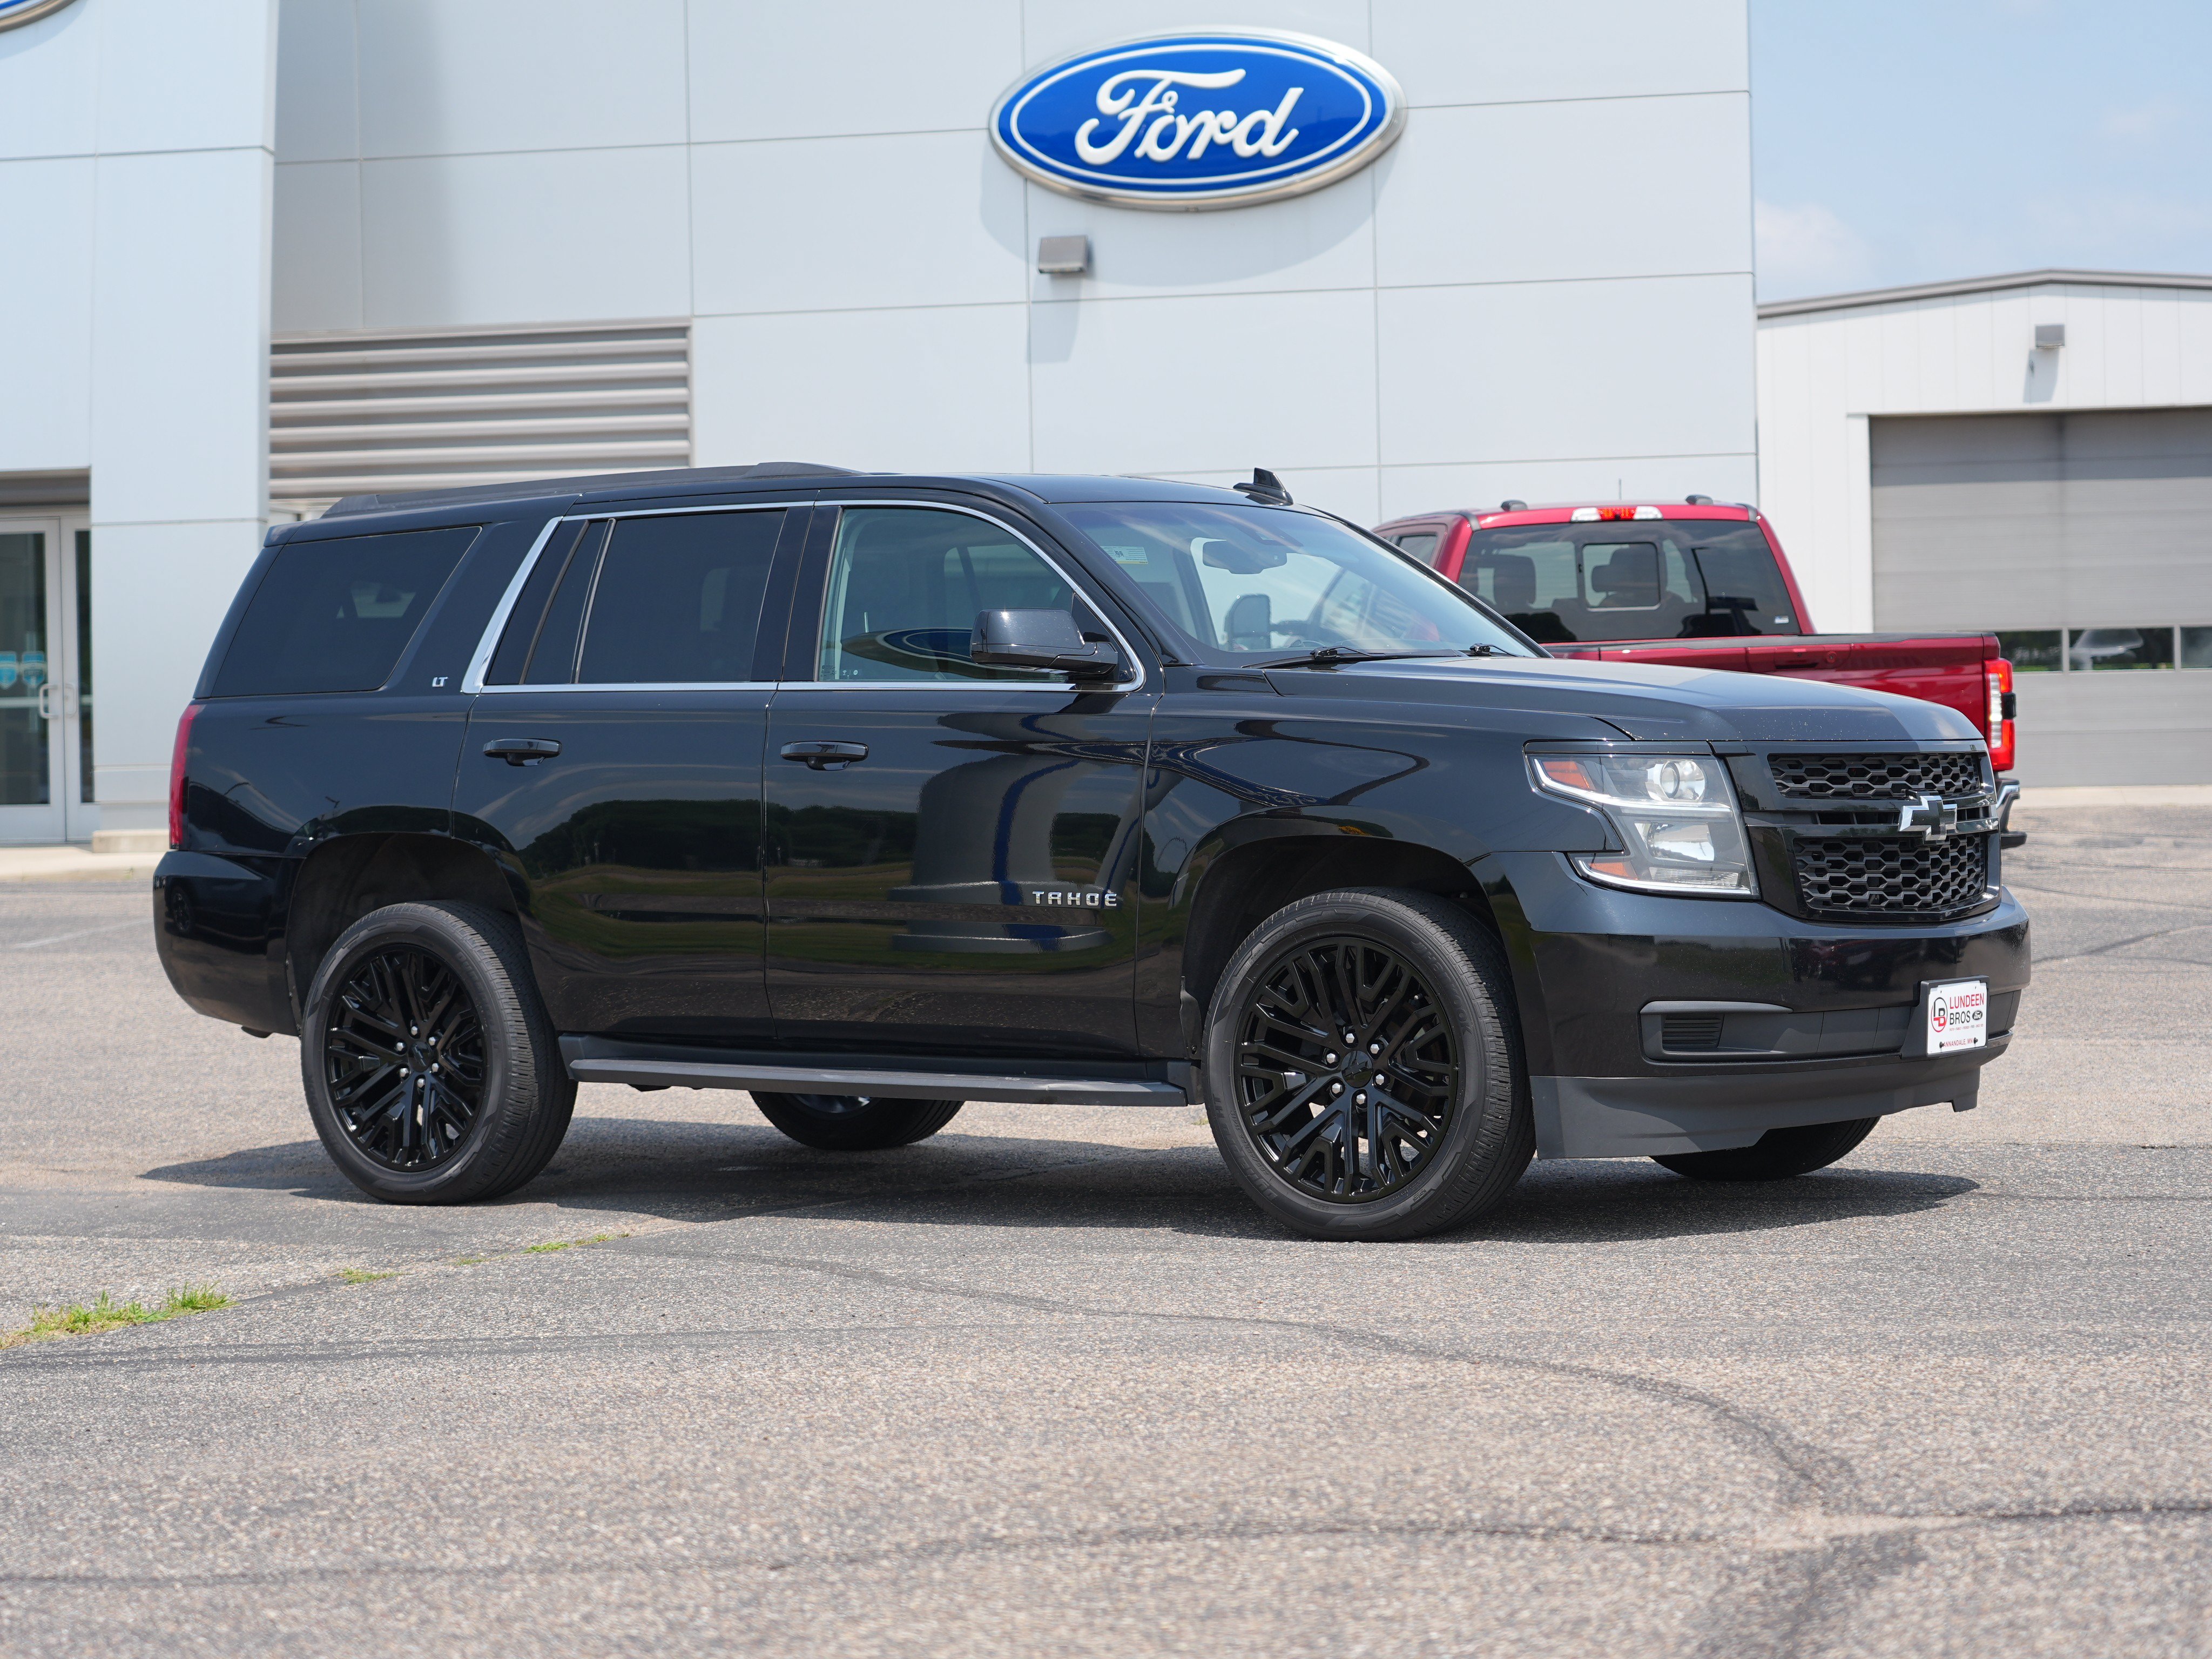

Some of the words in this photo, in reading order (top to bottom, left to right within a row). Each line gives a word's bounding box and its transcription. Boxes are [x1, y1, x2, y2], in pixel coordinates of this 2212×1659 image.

[1075, 69, 1304, 165] Ford
[432, 677, 448, 687] LT
[1032, 891, 1117, 907] TAHOE
[1950, 993, 1984, 1009] LUNDEEN
[1950, 1010, 1971, 1025] BROS
